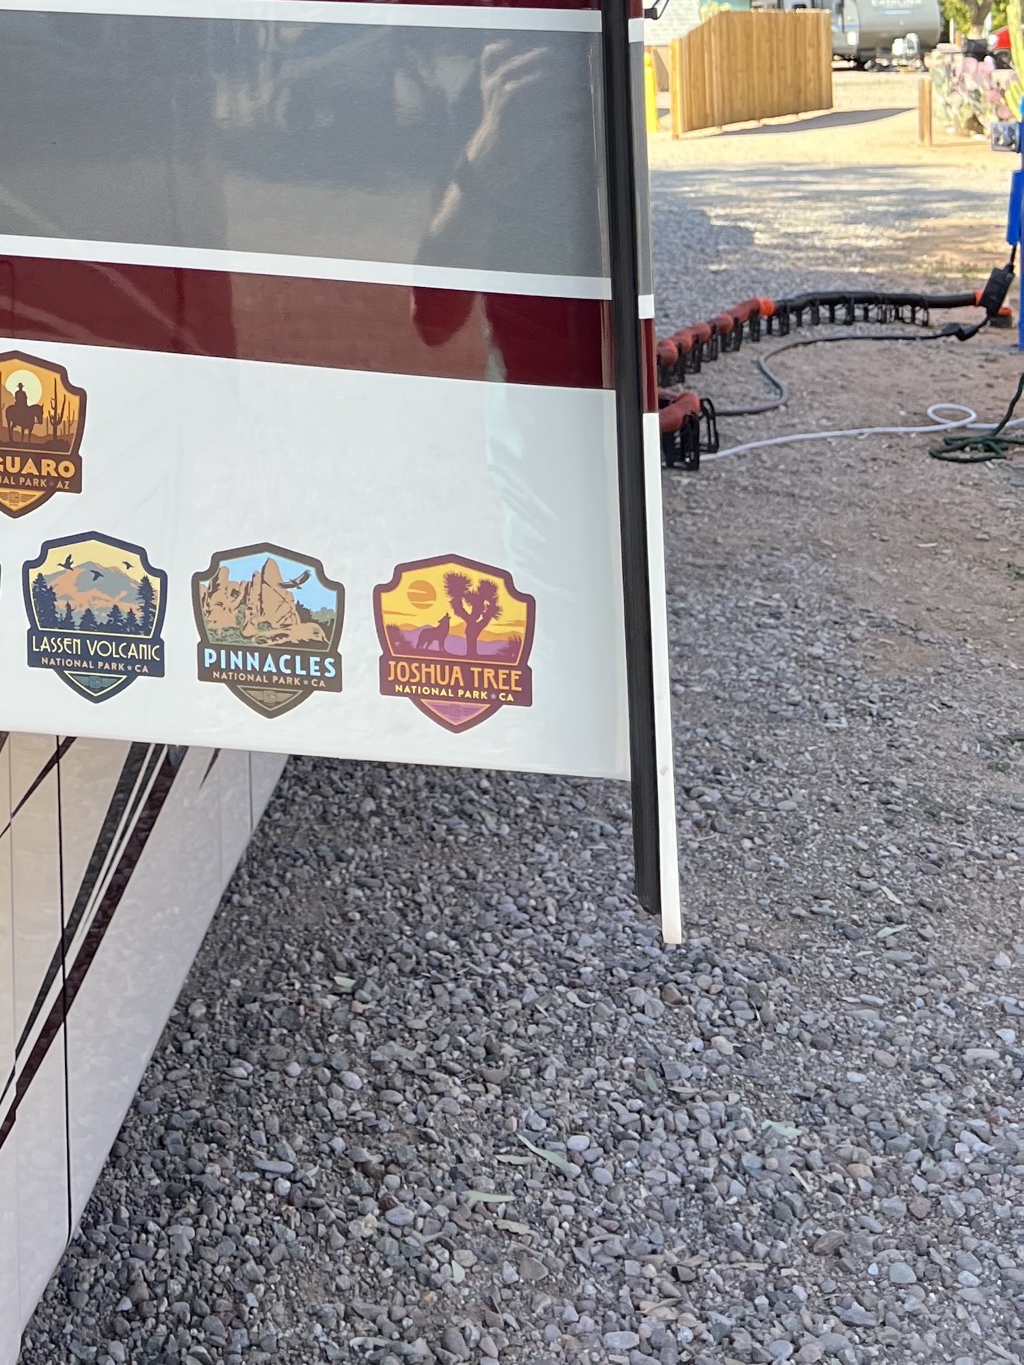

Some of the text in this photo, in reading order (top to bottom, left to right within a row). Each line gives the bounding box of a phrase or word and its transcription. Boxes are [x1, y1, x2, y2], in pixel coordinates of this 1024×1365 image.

[19, 476, 47, 487] PARK
[56, 481, 70, 489] AZ
[32, 635, 160, 661] LASSEN VOLCANIC
[41, 657, 149, 673] NATIONAL PARK CA
[204, 648, 336, 678] PINNACLES
[212, 671, 326, 688] NATIONAL PARK CA
[387, 660, 522, 692] JOSHUA TREE
[394, 684, 514, 702] NATIONAL PARK CA
